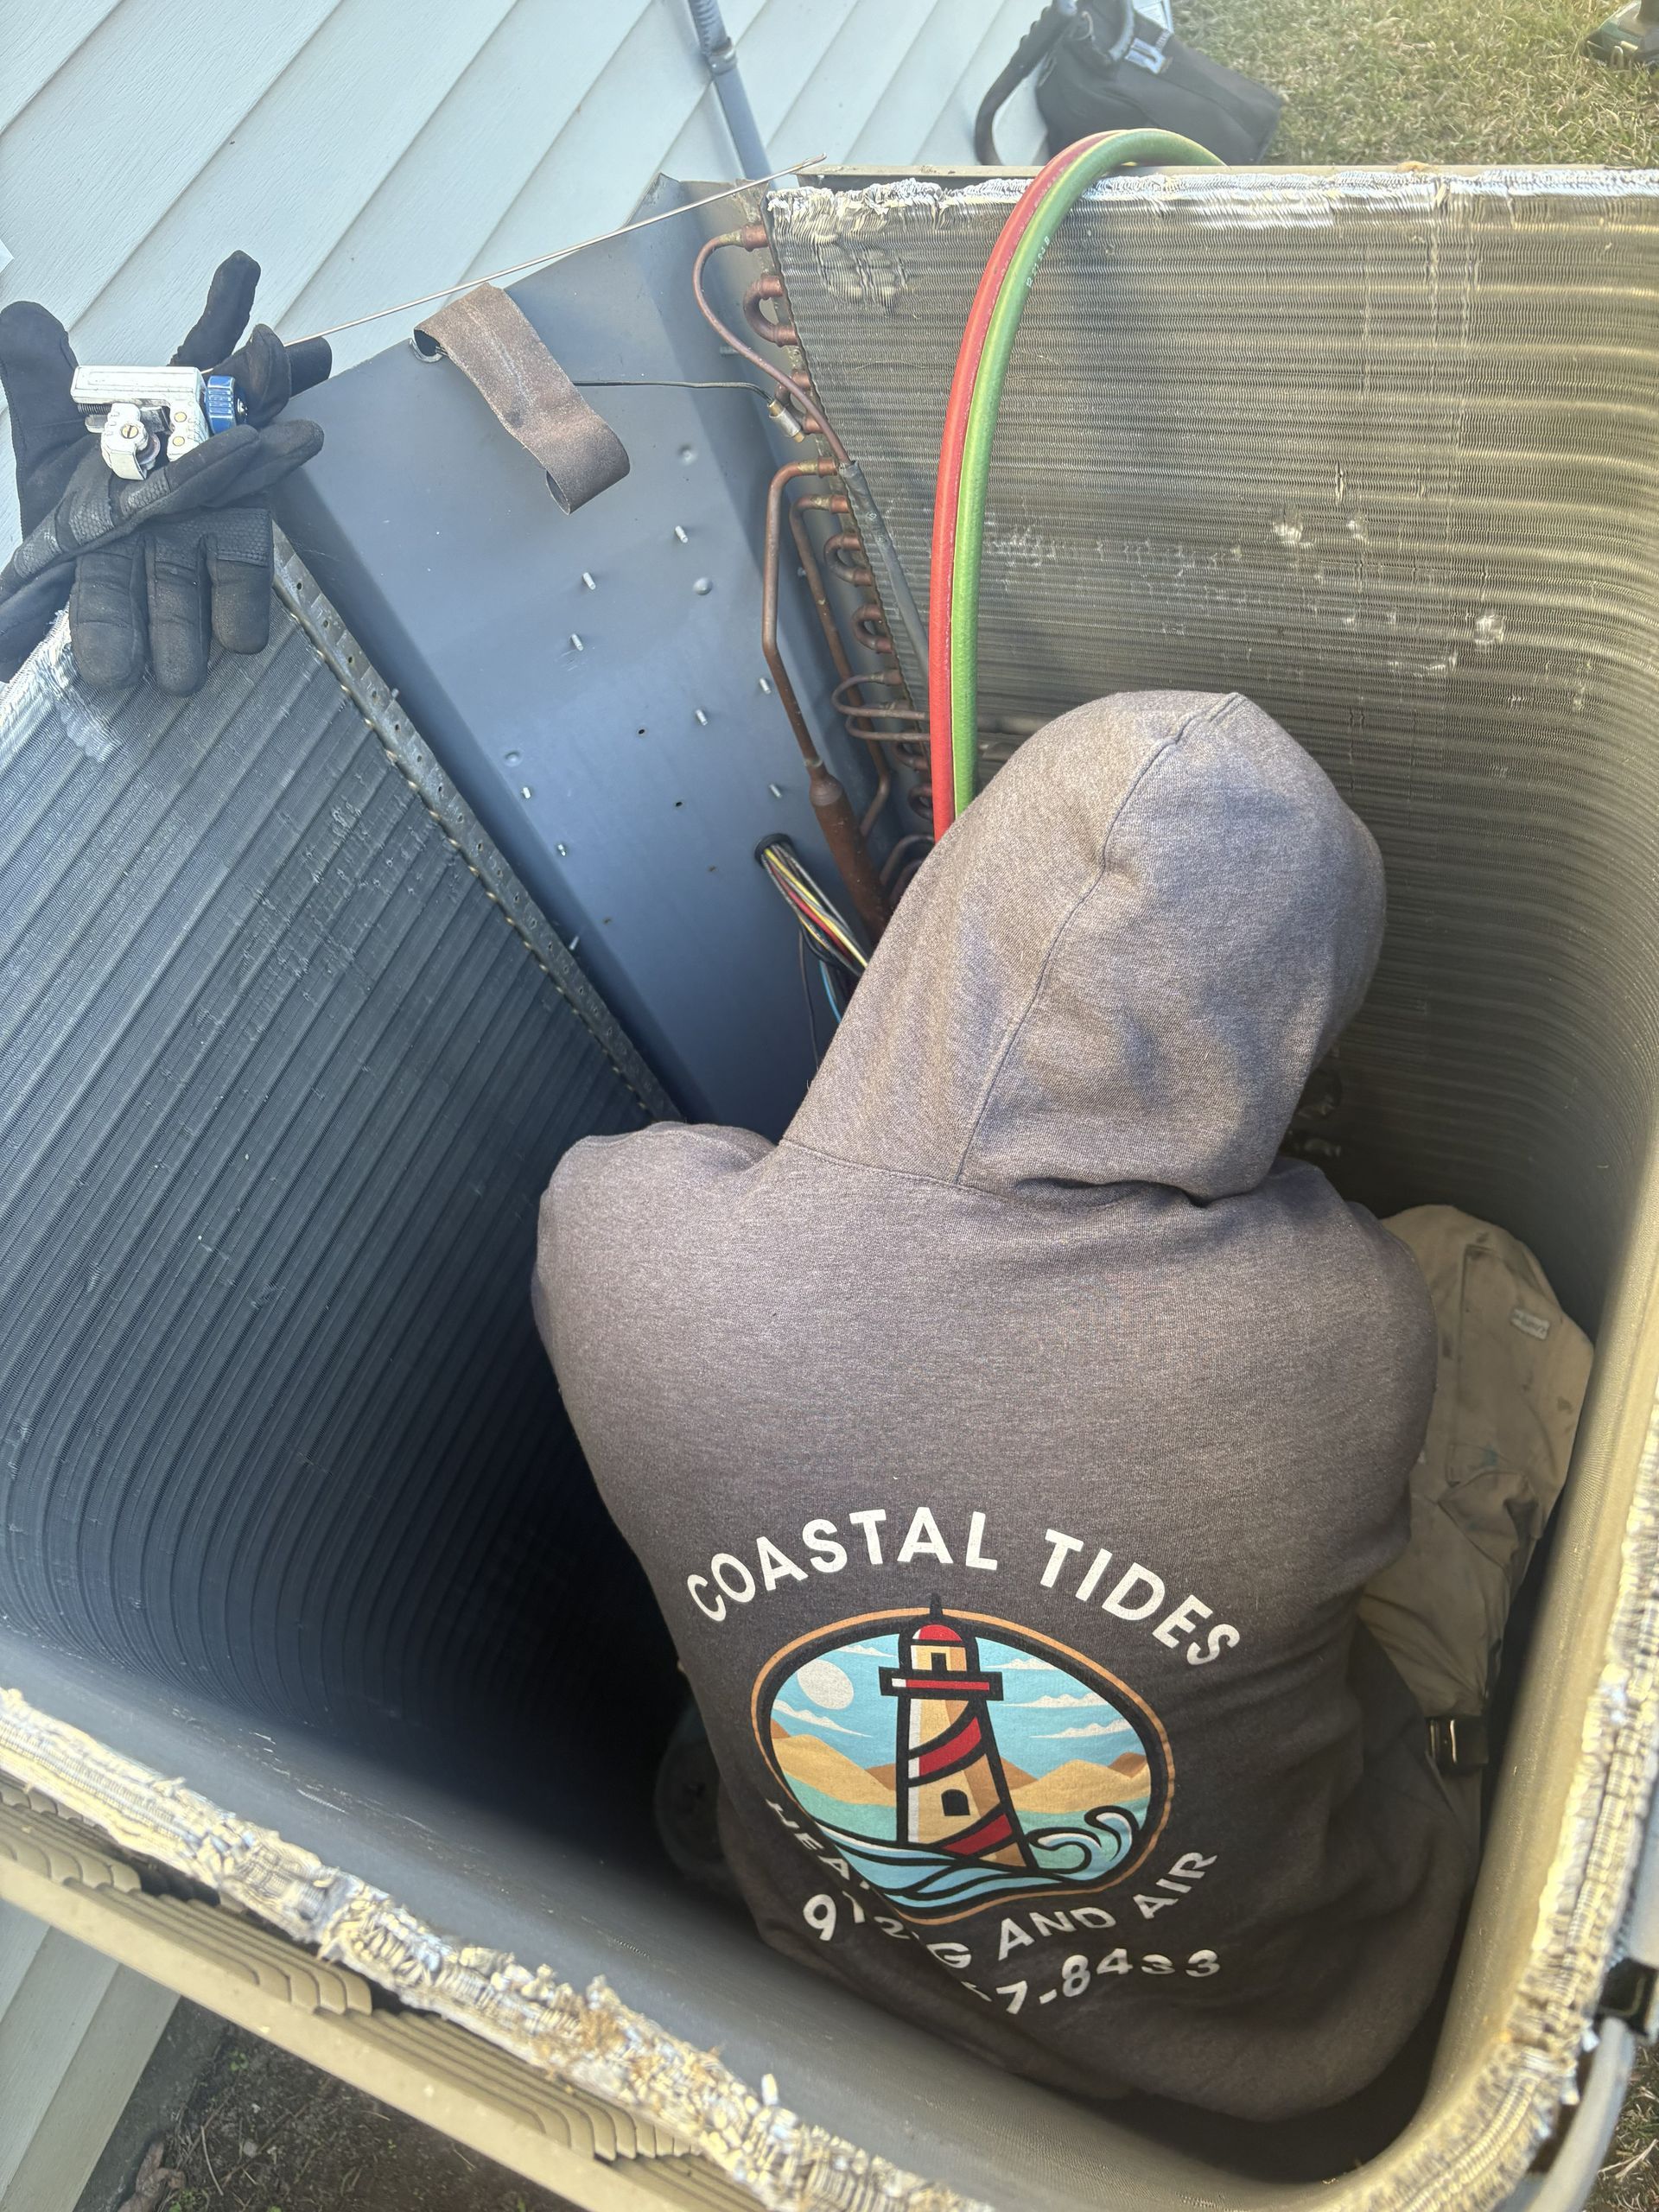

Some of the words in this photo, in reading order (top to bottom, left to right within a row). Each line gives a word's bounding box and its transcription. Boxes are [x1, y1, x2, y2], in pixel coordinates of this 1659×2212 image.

[686, 1506, 999, 1623] COASTAL
[1036, 1529, 1241, 1667] TIDES
[997, 1906, 1117, 1961] AND
[1132, 1852, 1218, 1920] AIR
